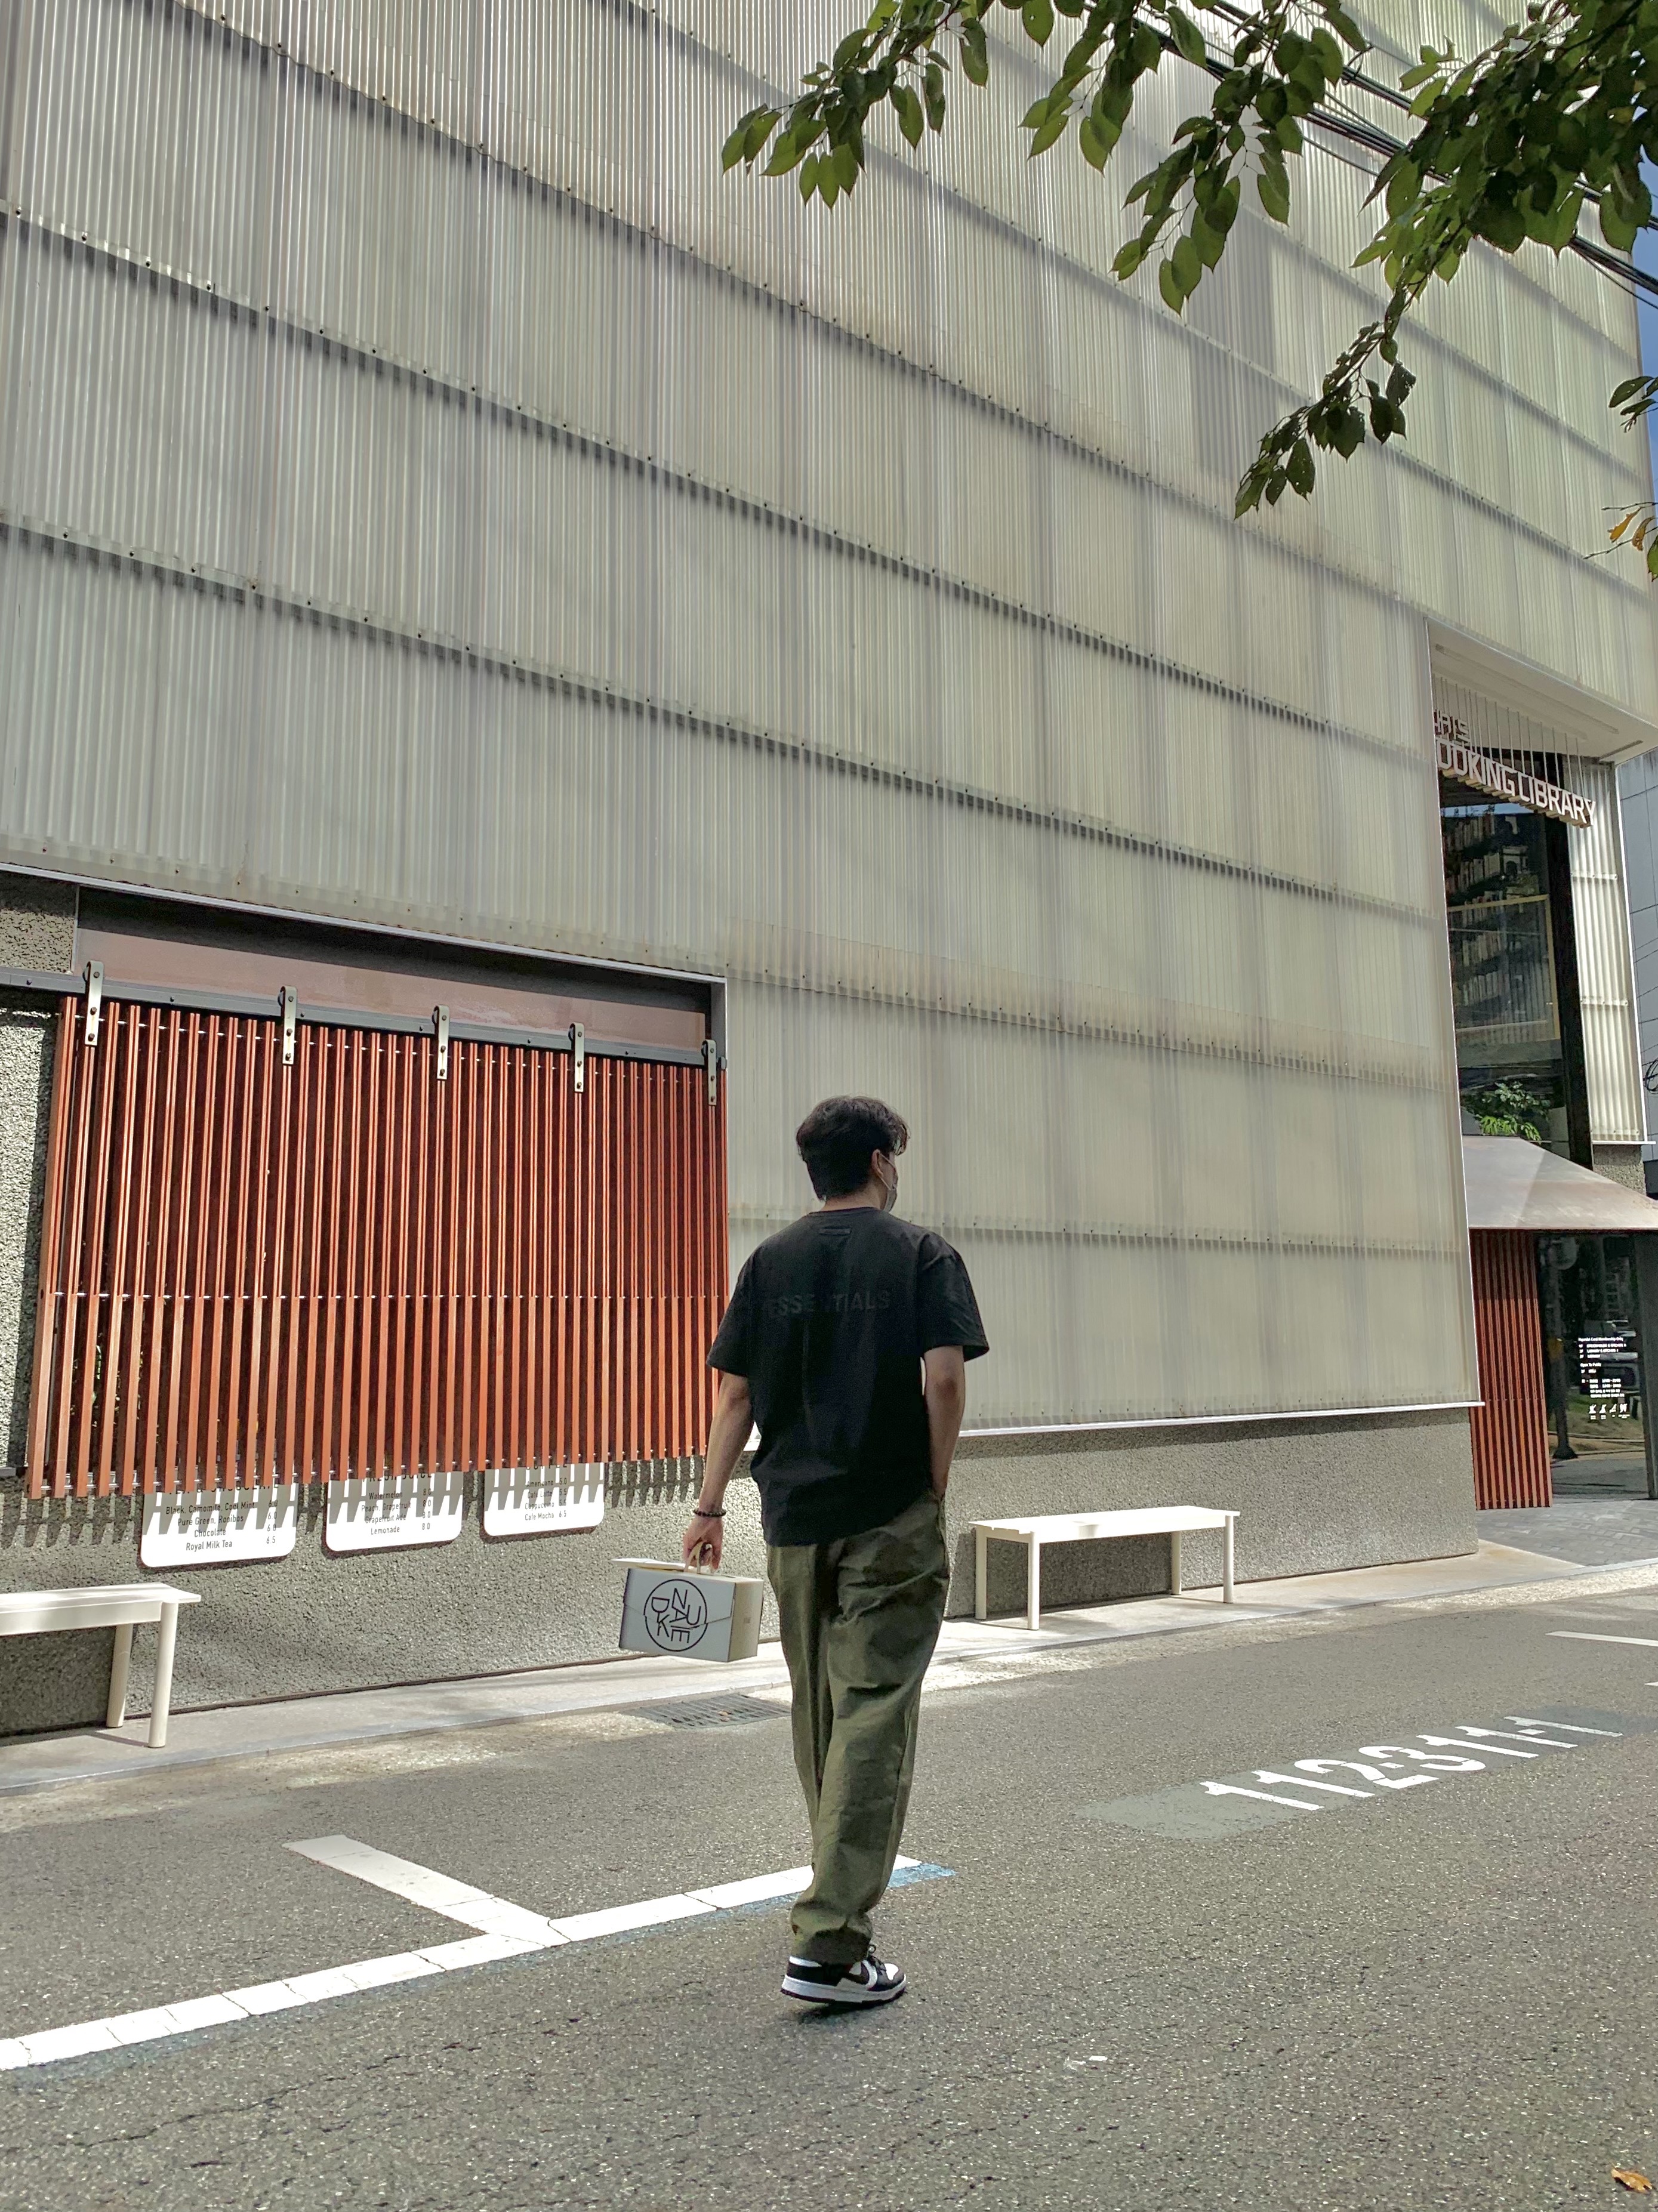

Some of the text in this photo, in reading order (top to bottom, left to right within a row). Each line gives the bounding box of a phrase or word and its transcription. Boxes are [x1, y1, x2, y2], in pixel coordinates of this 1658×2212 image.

[1434, 738, 1596, 826] OOKING LIBRARY
[765, 1290, 891, 1317] ESSETIALS
[369, 1491, 403, 1500] Watermelon
[178, 1517, 193, 1526] Pure
[218, 1515, 244, 1523] Rooibos
[194, 1529, 226, 1538] Chocolate
[371, 1525, 400, 1535] Lemonade
[186, 1541, 204, 1552] Royal
[206, 1540, 220, 1549] Milk
[1199, 1715, 1623, 1811] 112-311-1
